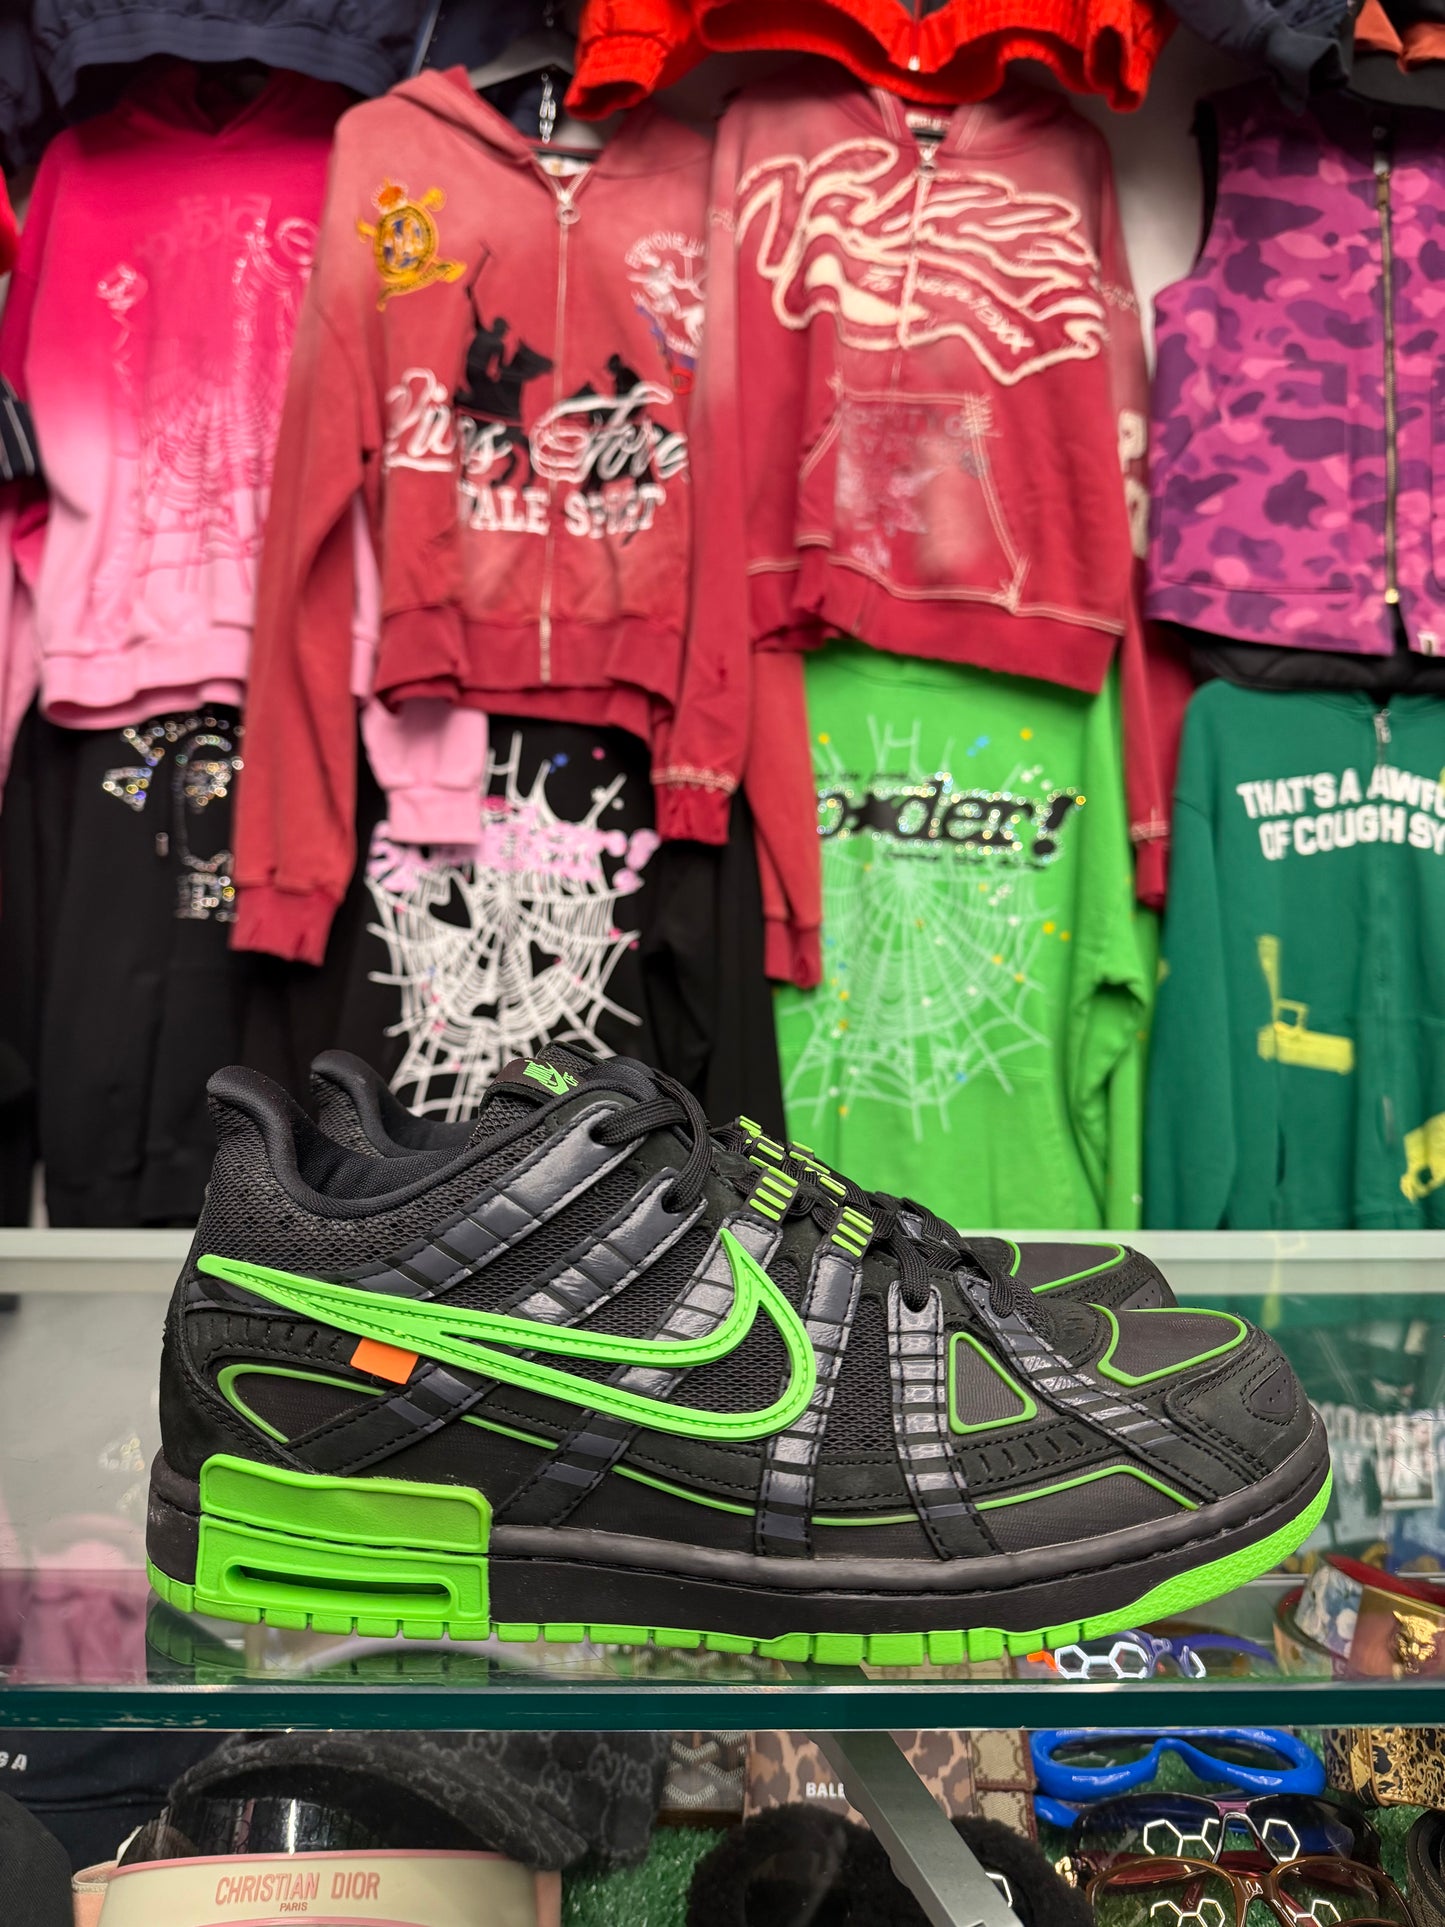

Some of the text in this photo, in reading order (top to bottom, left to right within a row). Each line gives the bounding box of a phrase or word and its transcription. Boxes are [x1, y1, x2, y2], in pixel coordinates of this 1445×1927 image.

[1235, 771, 1338, 819] THAT'S
[1338, 767, 1363, 804] A
[1258, 819, 1292, 861] OF
[1293, 803, 1407, 856] COUGH
[215, 1871, 381, 1906] CHRISTIAN DIOR
[279, 1901, 309, 1912] PARIS
